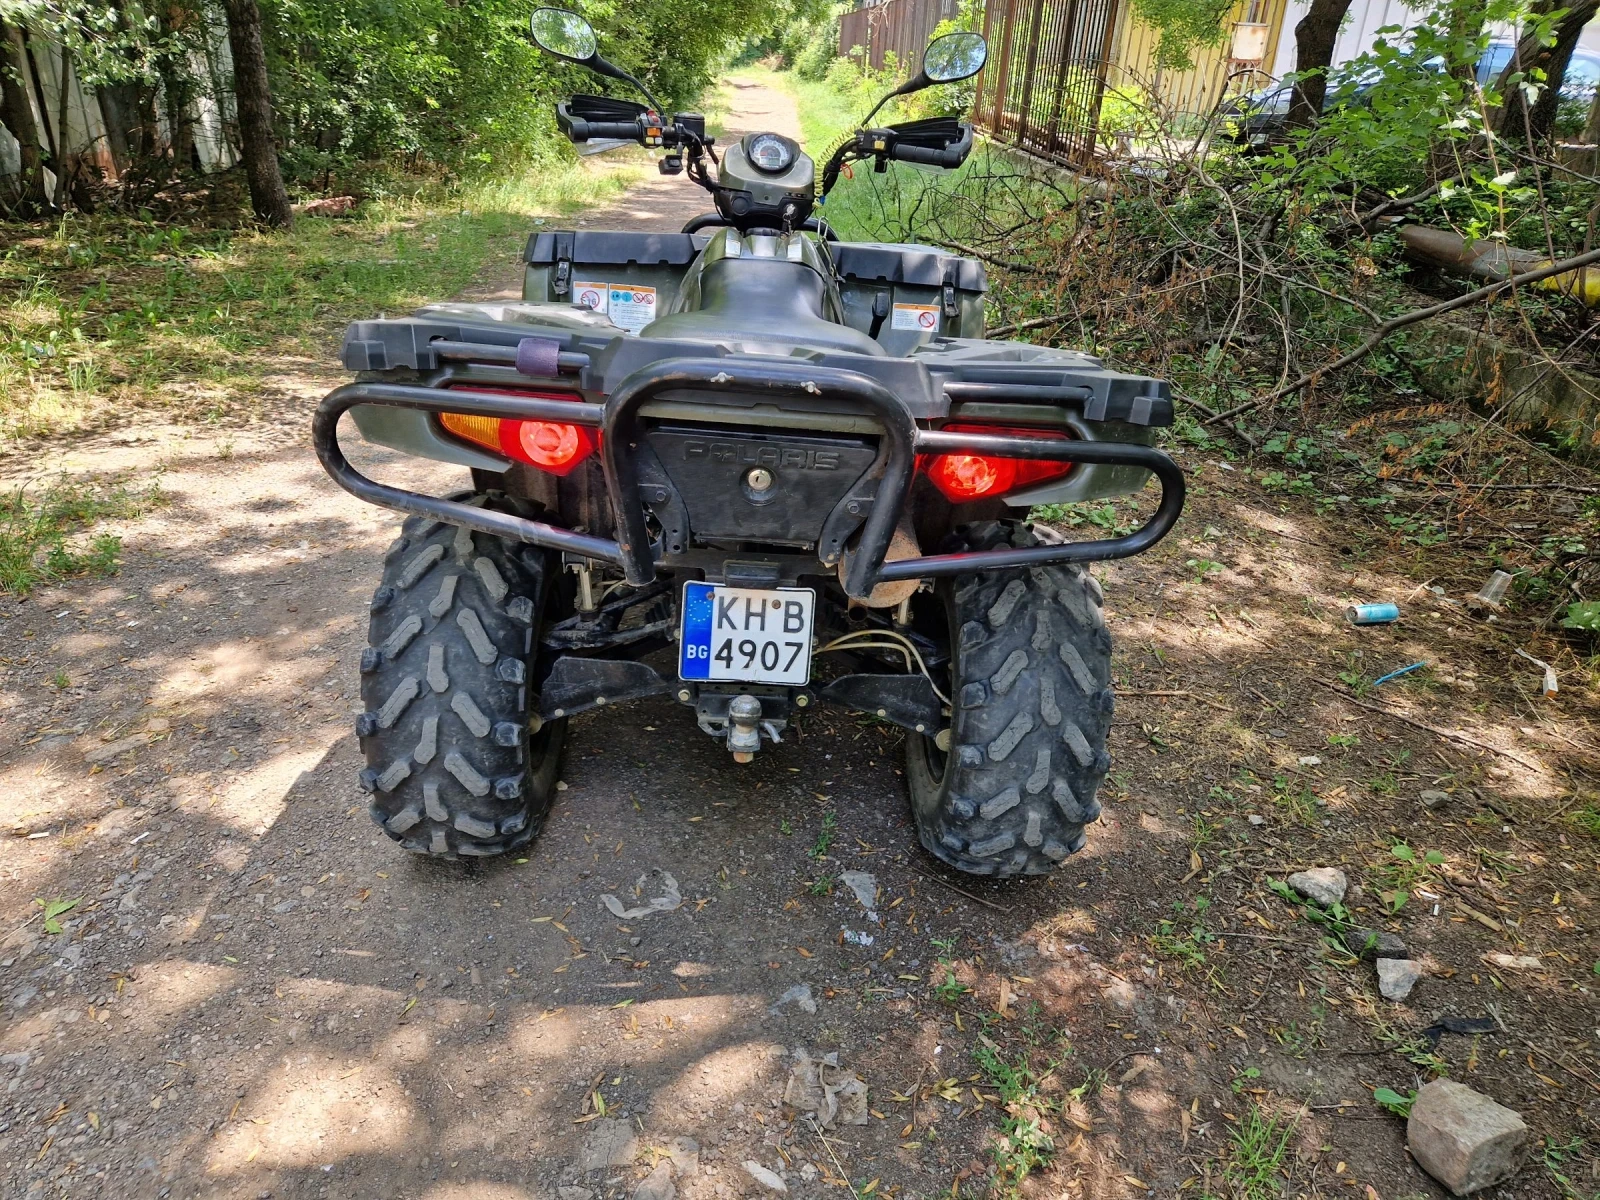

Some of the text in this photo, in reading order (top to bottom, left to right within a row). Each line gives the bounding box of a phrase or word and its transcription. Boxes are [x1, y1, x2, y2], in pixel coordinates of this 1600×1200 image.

[683, 440, 840, 470] POLARIS
[686, 644, 709, 659] BG
[714, 638, 804, 673] 4907
